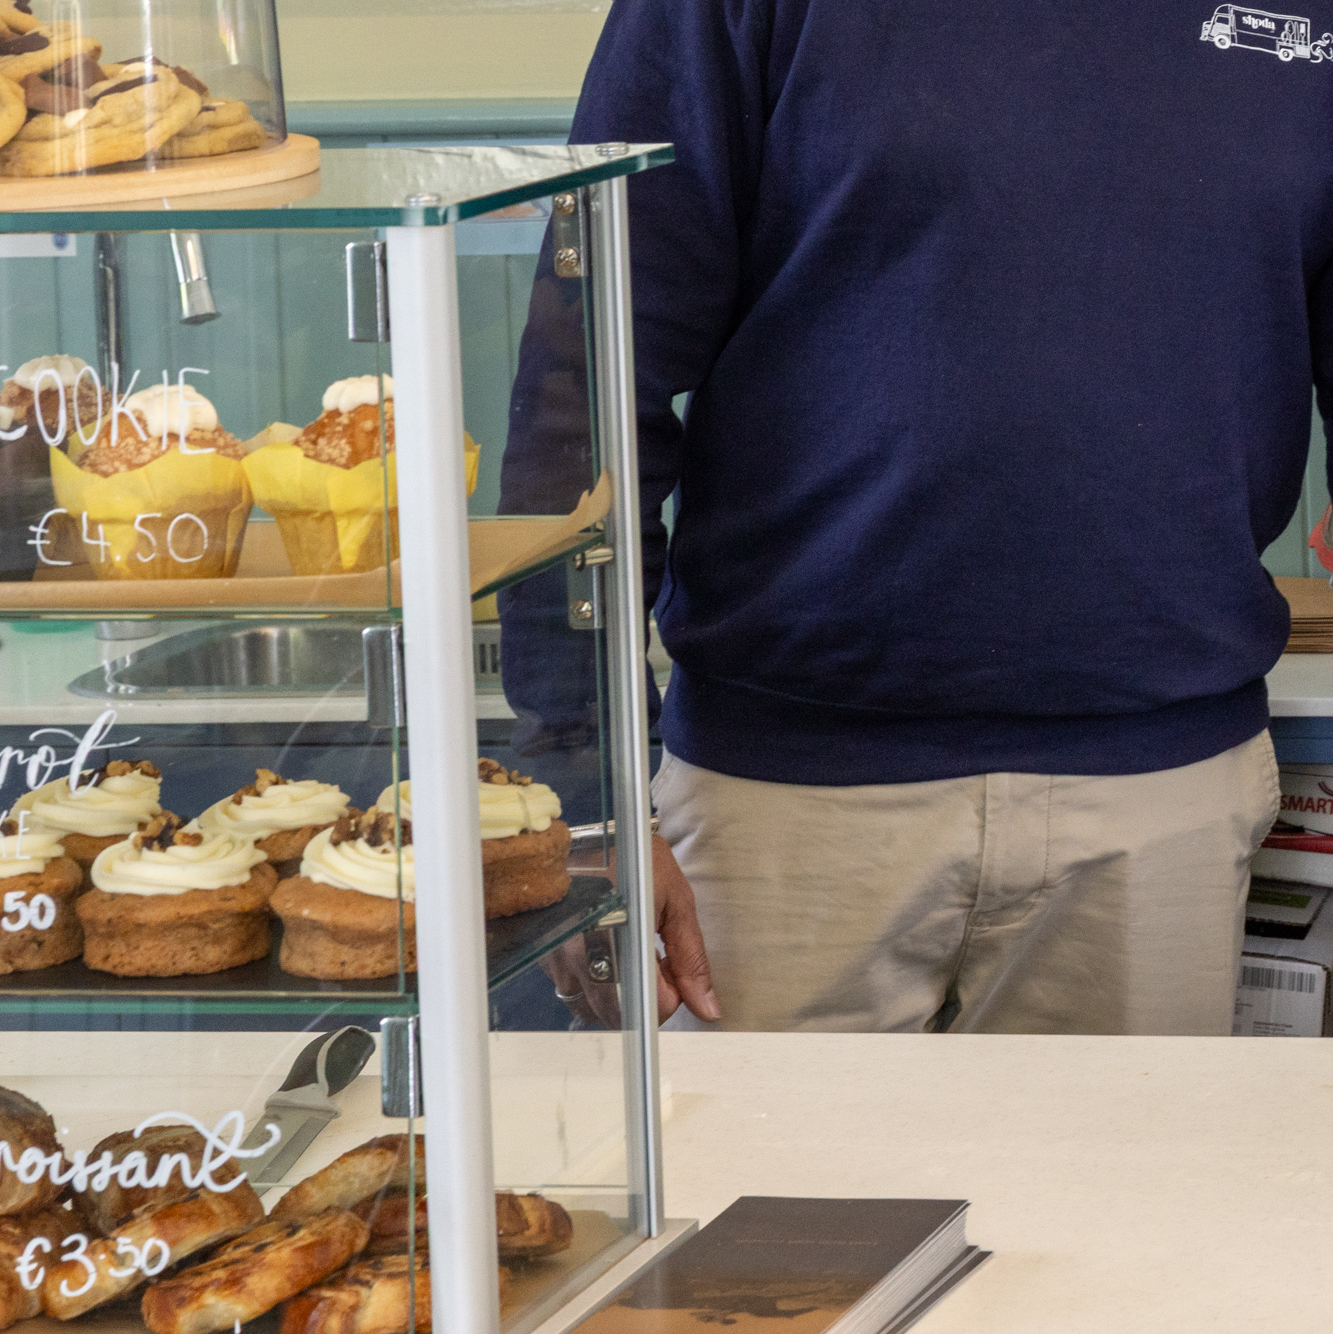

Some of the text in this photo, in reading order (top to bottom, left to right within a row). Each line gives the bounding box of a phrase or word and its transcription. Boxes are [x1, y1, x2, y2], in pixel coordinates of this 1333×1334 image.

[1242, 15, 1276, 30] shoda
[27, 508, 209, 566] €4.50
[15, 1233, 170, 1297] €3.50
